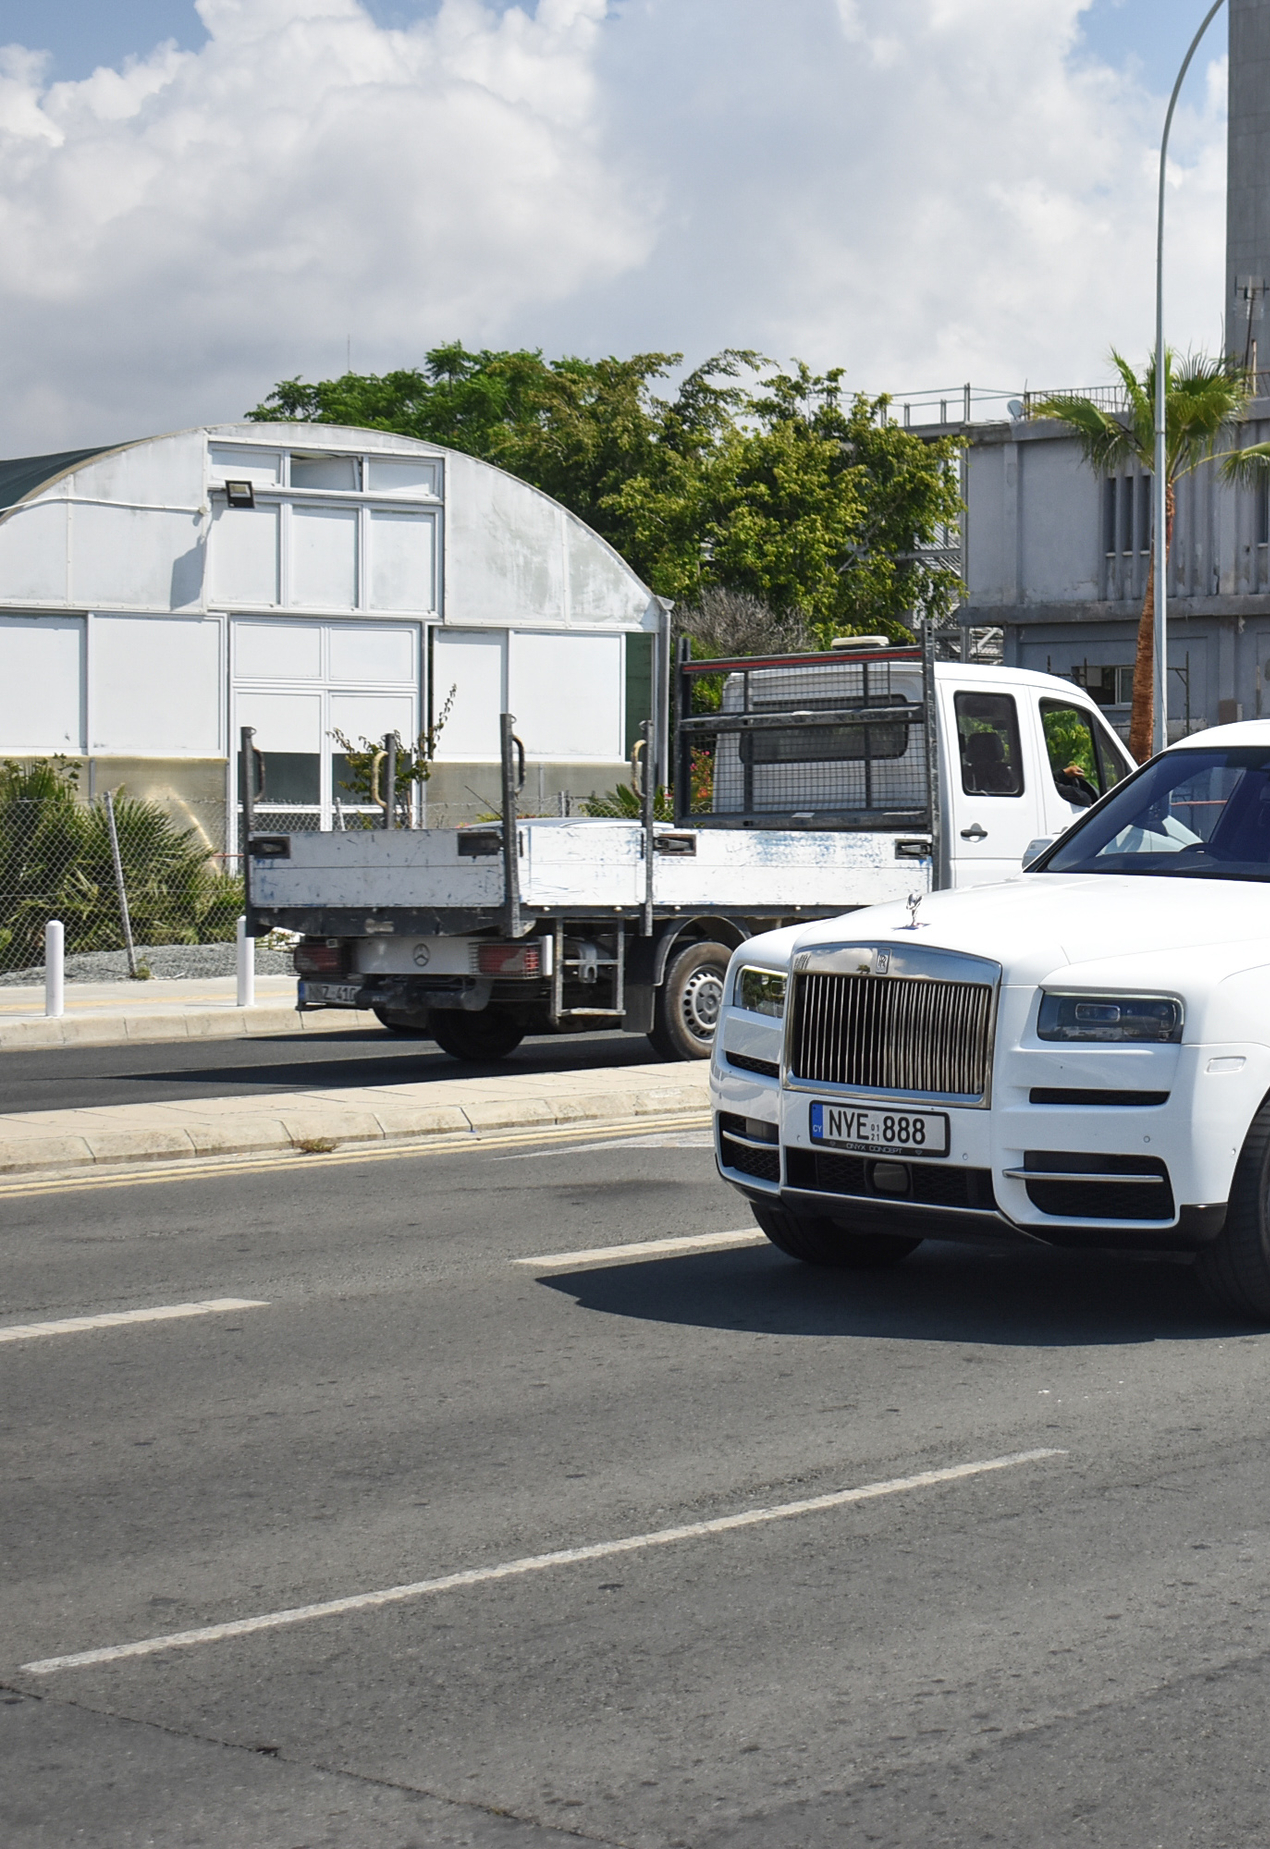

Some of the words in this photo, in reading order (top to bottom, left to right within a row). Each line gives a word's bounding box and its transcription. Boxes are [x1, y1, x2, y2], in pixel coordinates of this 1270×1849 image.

[813, 1124, 822, 1133] CY
[829, 1109, 869, 1140] NYE
[870, 1123, 880, 1132] 01
[883, 1115, 925, 1145] 888
[870, 1133, 880, 1142] 21
[846, 1143, 866, 1151] ONYX
[868, 1145, 903, 1154] CONCEPT
